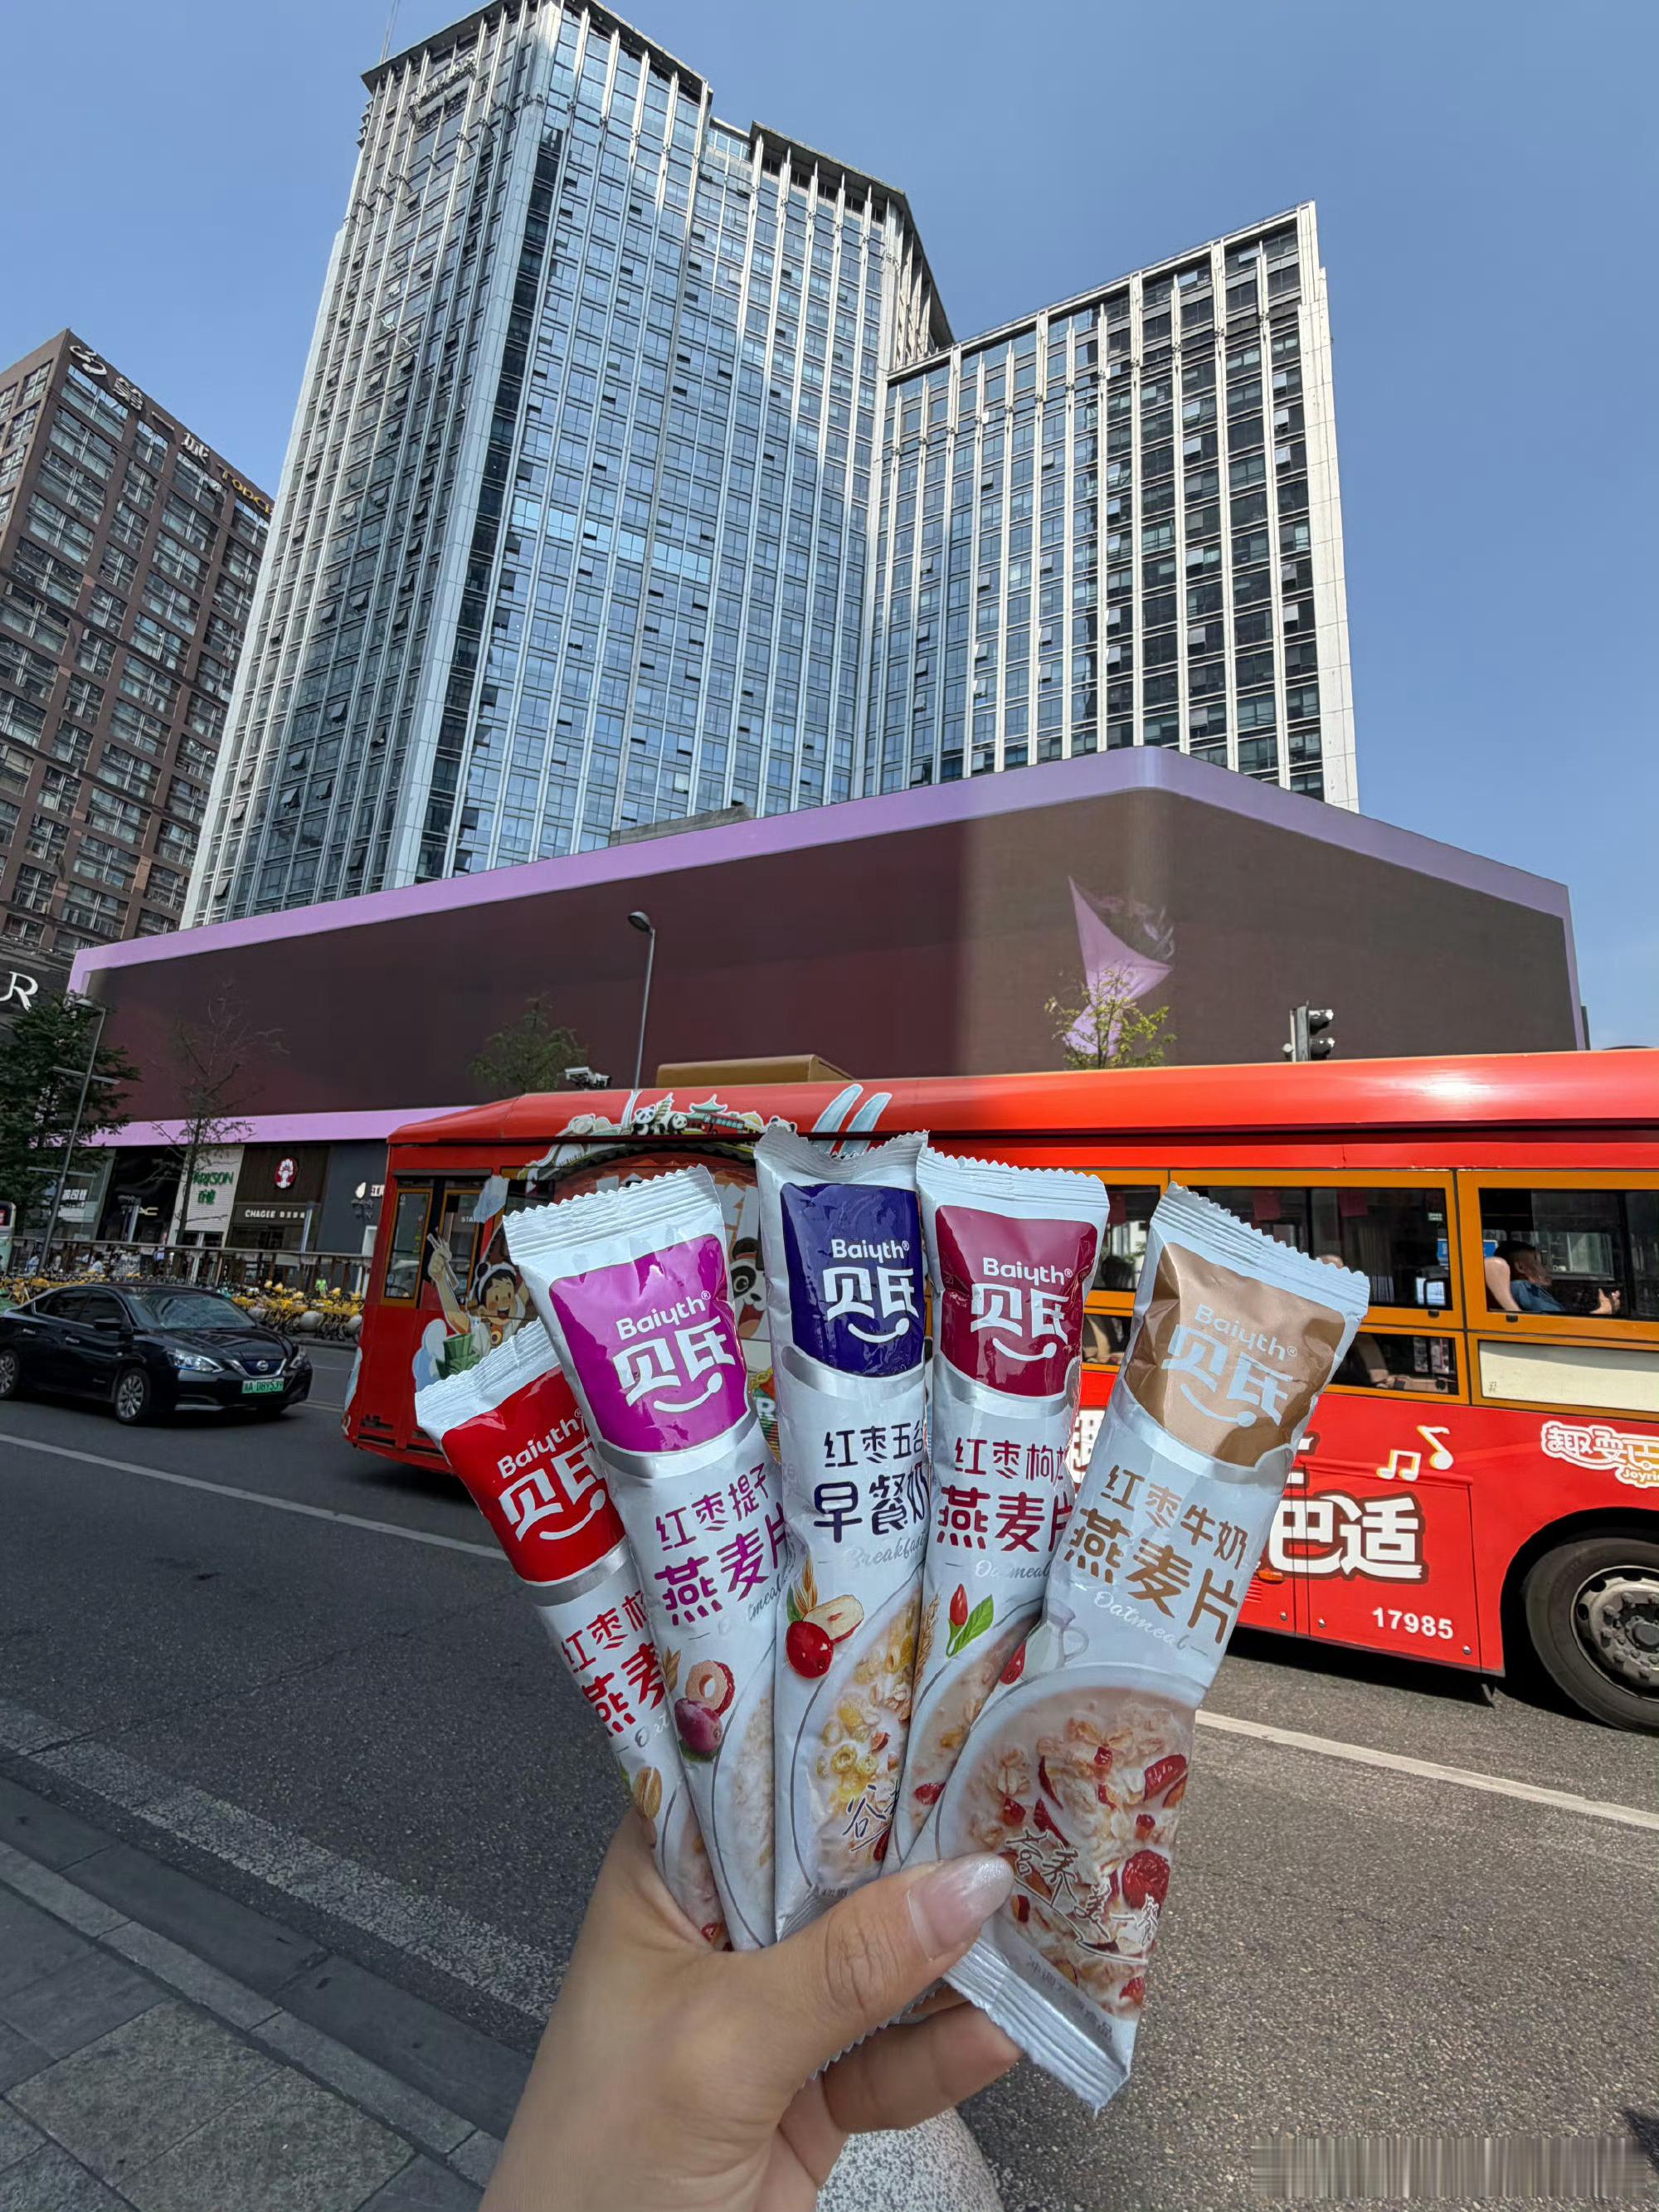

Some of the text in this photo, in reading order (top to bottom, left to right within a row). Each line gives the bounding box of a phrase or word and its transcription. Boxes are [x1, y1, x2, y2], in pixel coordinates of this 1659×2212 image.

[822, 1266, 918, 1321] 贝氏
[971, 1282, 1071, 1345] 贝氏
[613, 1315, 736, 1407] 贝氏
[1161, 1324, 1295, 1426] 贝氏
[655, 1462, 768, 1552] 红枣提子
[937, 1483, 1073, 1553] 燕麦片
[1100, 1465, 1248, 1571] 红枣牛奶
[1623, 1467, 1659, 1483] Joyri
[654, 1502, 785, 1626] 燕麦片
[1064, 1505, 1238, 1645] 燕麦片
[1372, 1607, 1453, 1640] 17985
